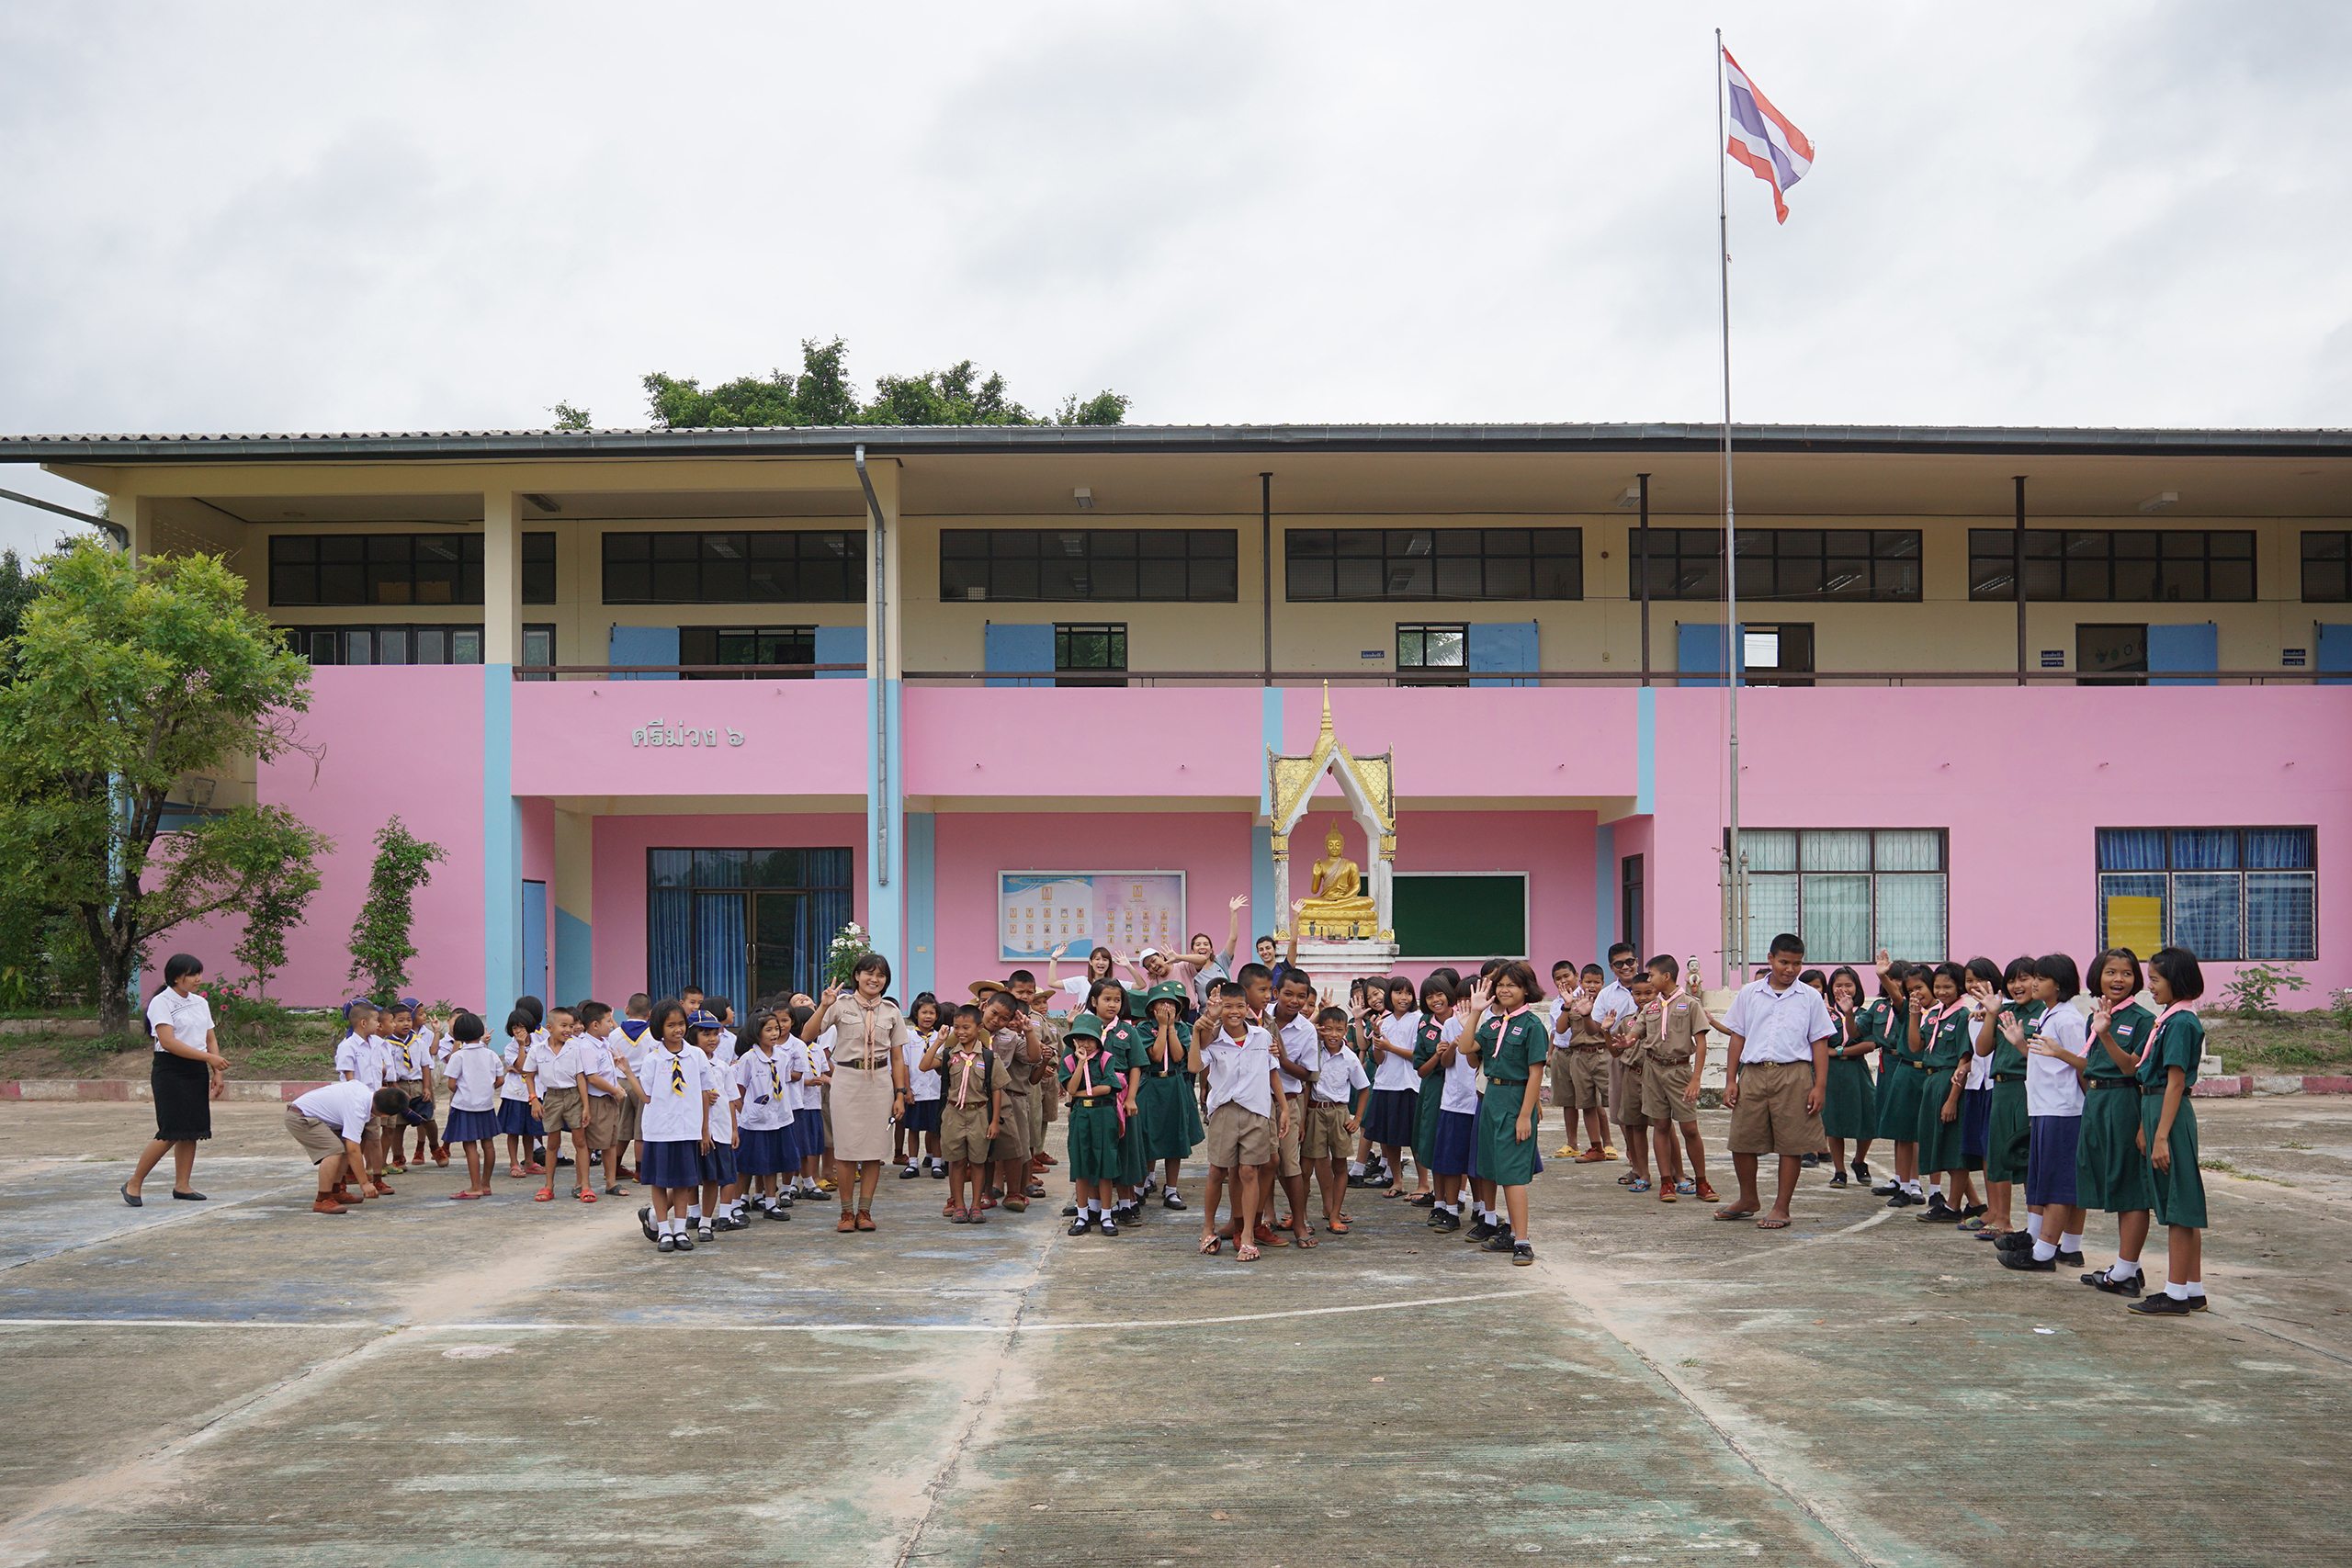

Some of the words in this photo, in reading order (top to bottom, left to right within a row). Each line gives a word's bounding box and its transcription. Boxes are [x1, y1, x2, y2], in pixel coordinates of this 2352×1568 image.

[631, 717, 718, 747] ศรีม่วง
[725, 726, 745, 747] ๖
